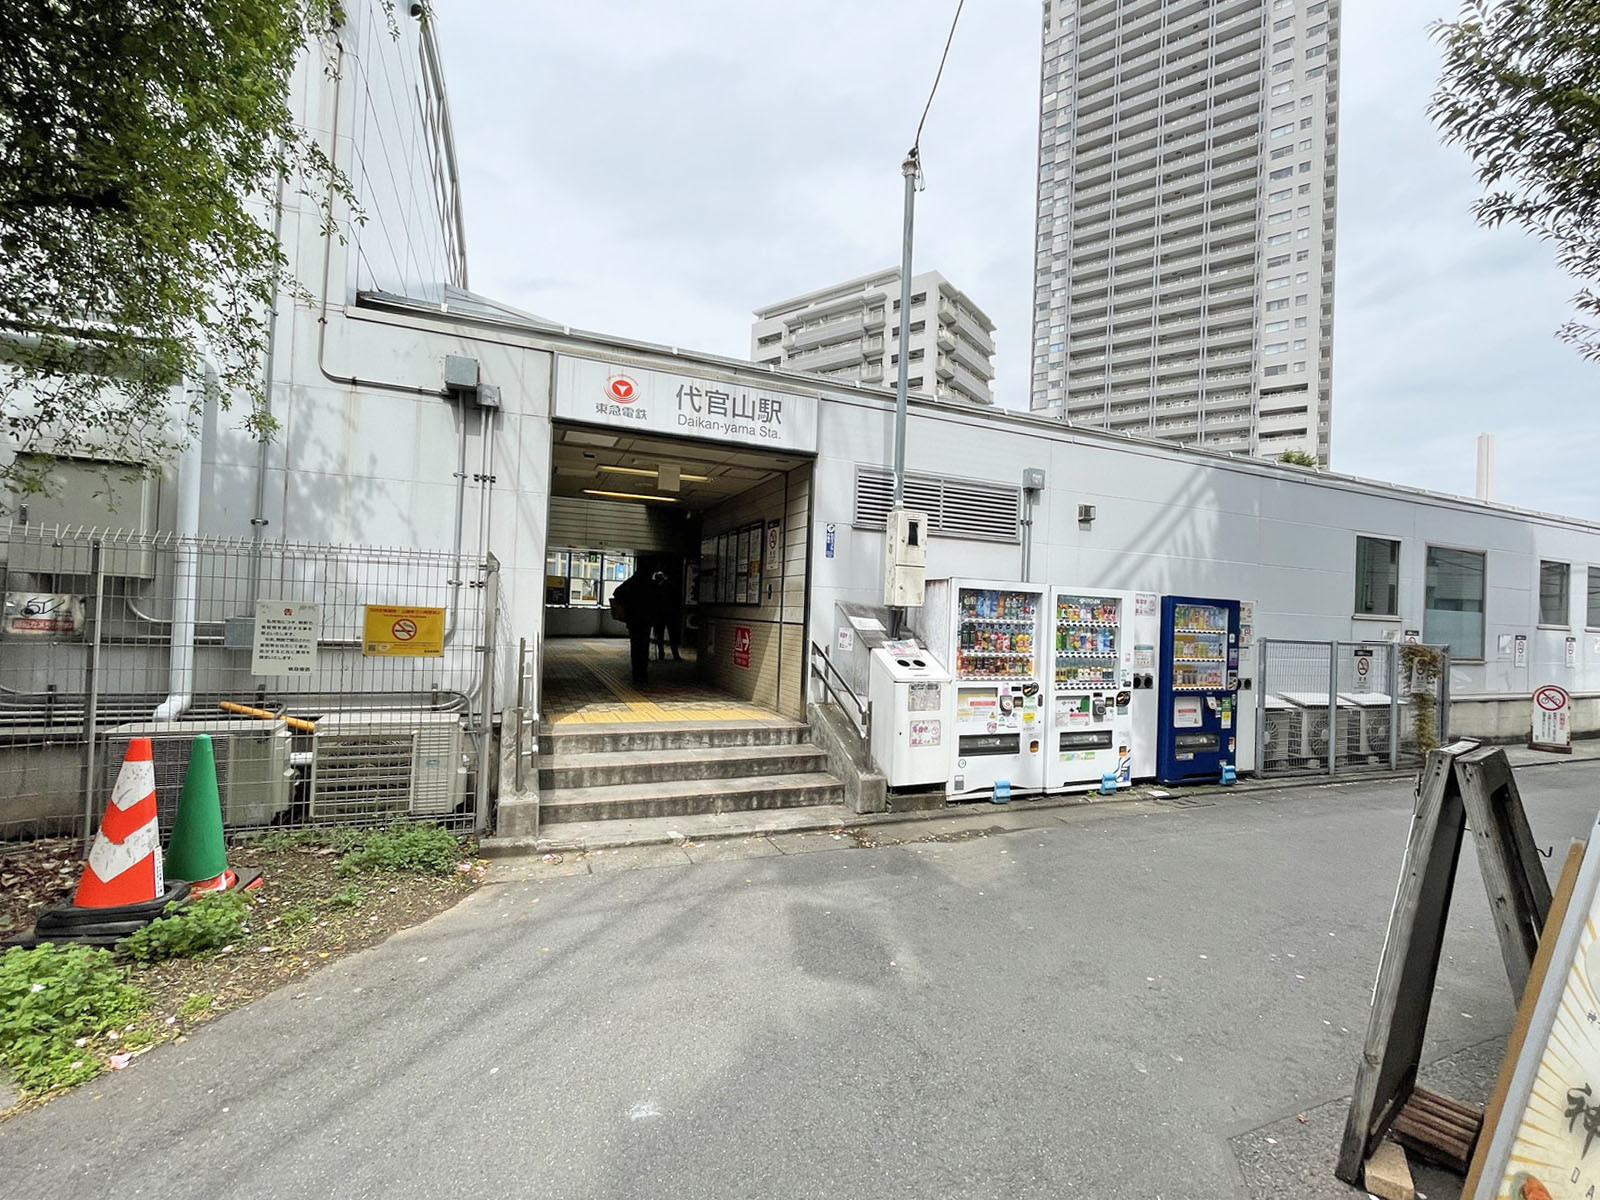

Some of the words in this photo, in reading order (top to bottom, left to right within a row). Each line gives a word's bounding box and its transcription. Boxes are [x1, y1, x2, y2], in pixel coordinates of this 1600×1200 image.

[595, 402, 648, 420] 東急電鉄
[676, 384, 782, 424] 代官山駅
[677, 414, 756, 434] Daikan-yama
[759, 425, 782, 440] Sta.
